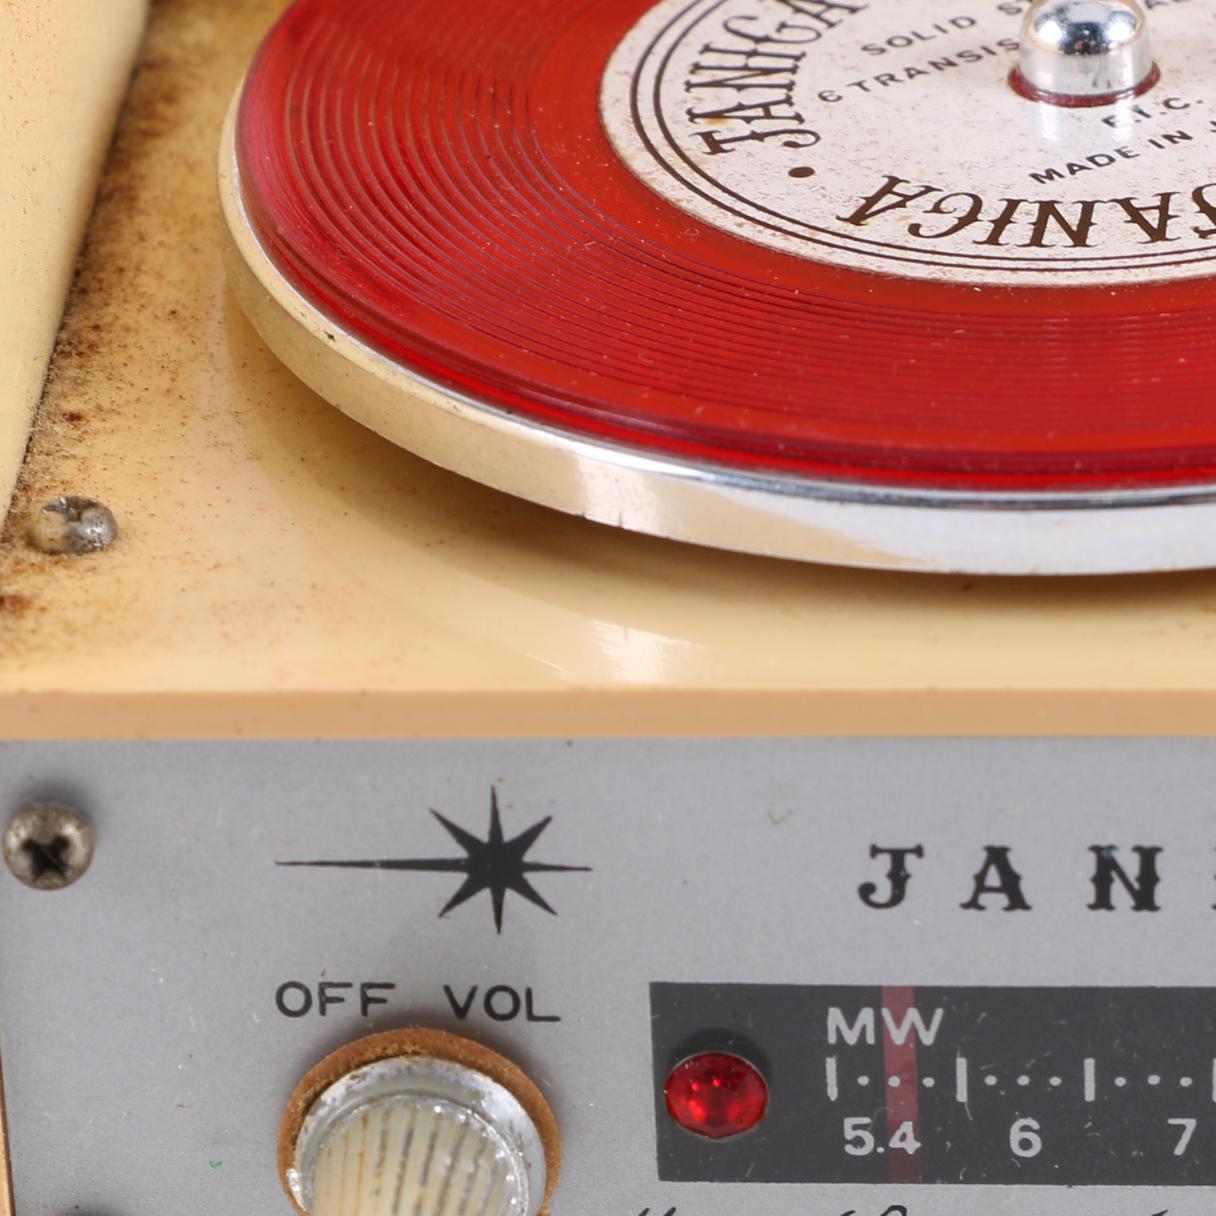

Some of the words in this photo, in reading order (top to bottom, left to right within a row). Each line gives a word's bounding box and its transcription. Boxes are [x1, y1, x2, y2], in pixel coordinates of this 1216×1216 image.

[861, 15, 976, 56] SOLID
[817, 90, 843, 103] 6
[846, 38, 1020, 92] TRANSIS
[1028, 145, 1140, 184] MADE
[1147, 130, 1194, 149] IN
[275, 981, 396, 1018] OFF
[443, 985, 561, 1022] VOL
[827, 1007, 944, 1045] MW
[842, 1117, 922, 1156] 5.4
[1009, 1118, 1043, 1158] 6
[1167, 1118, 1197, 1156] 7
